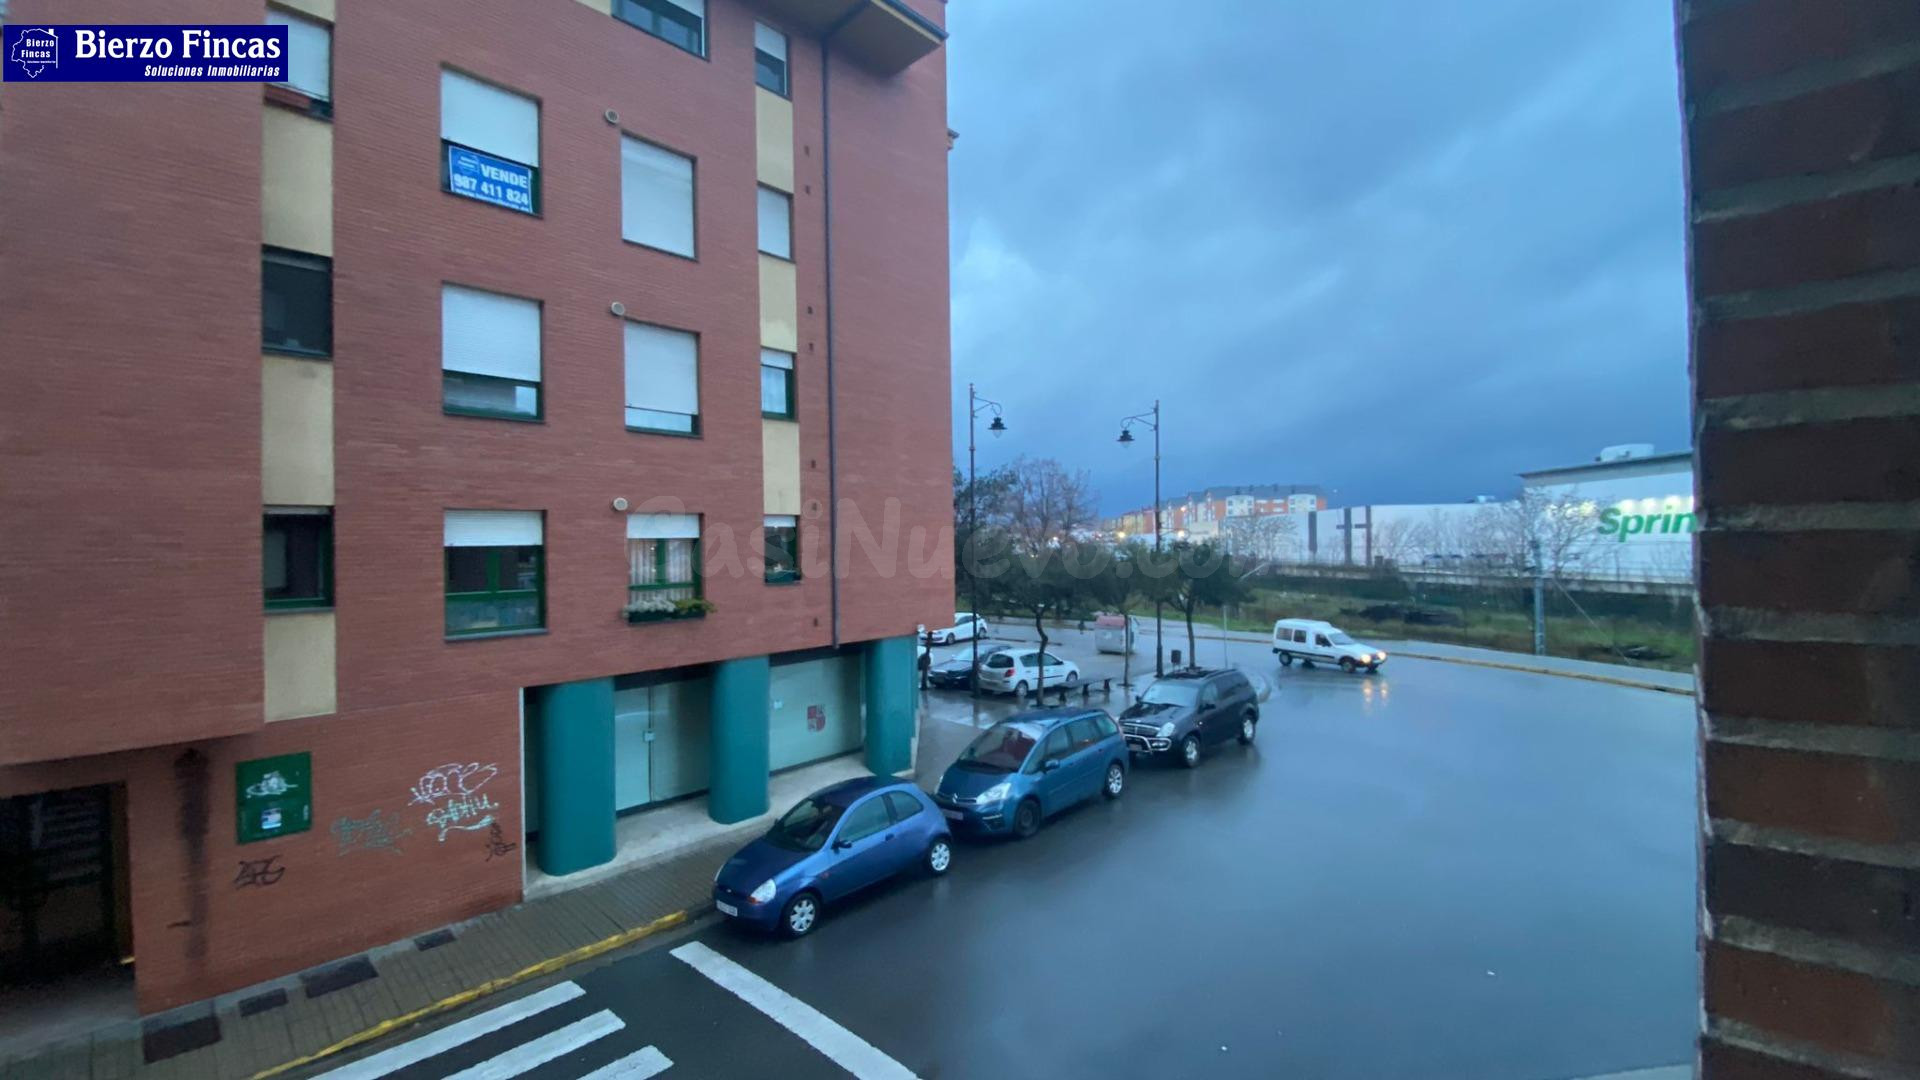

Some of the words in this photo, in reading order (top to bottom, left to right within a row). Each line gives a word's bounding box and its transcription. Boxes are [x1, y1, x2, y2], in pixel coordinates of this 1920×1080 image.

[453, 173, 478, 191] 987
[481, 181, 503, 198] 411
[506, 188, 529, 206] 824
[480, 163, 529, 189] VENDE
[1597, 504, 1697, 543] Sprin
